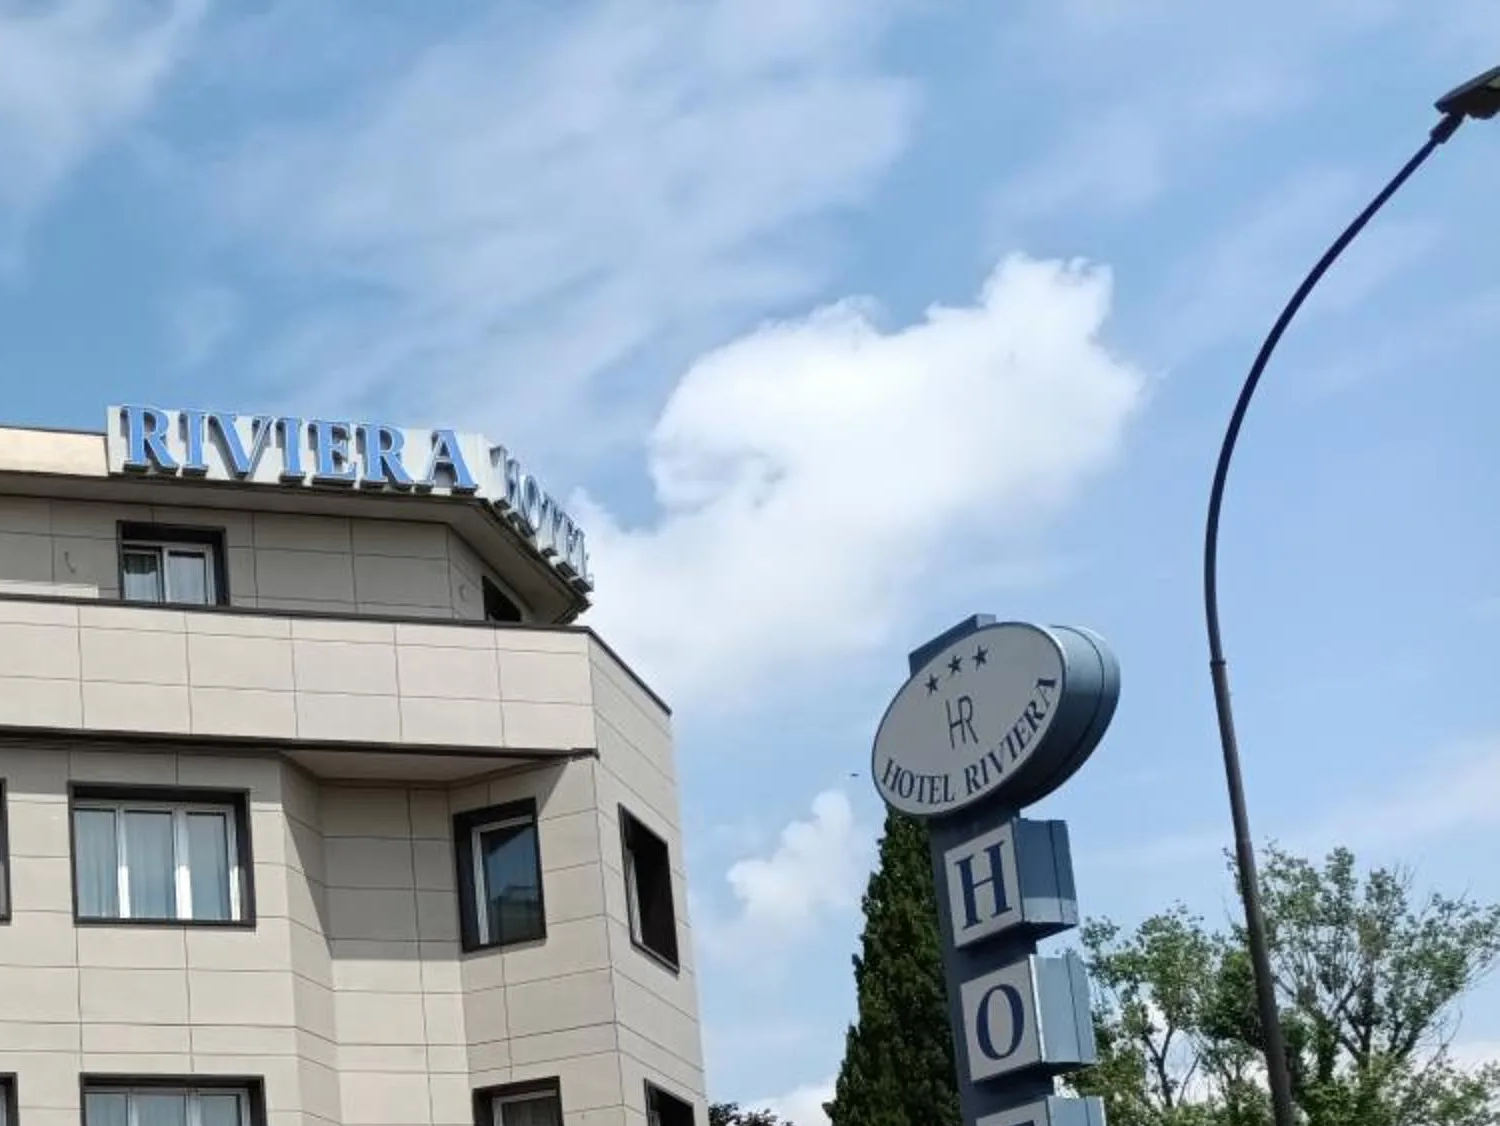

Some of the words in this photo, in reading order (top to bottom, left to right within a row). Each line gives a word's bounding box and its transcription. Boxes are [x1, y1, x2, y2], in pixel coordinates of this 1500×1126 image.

[120, 404, 479, 492] RIVIERA
[881, 758, 956, 805] HOTEL
[964, 676, 1057, 795] RIVIERA
[945, 695, 979, 750] HR
